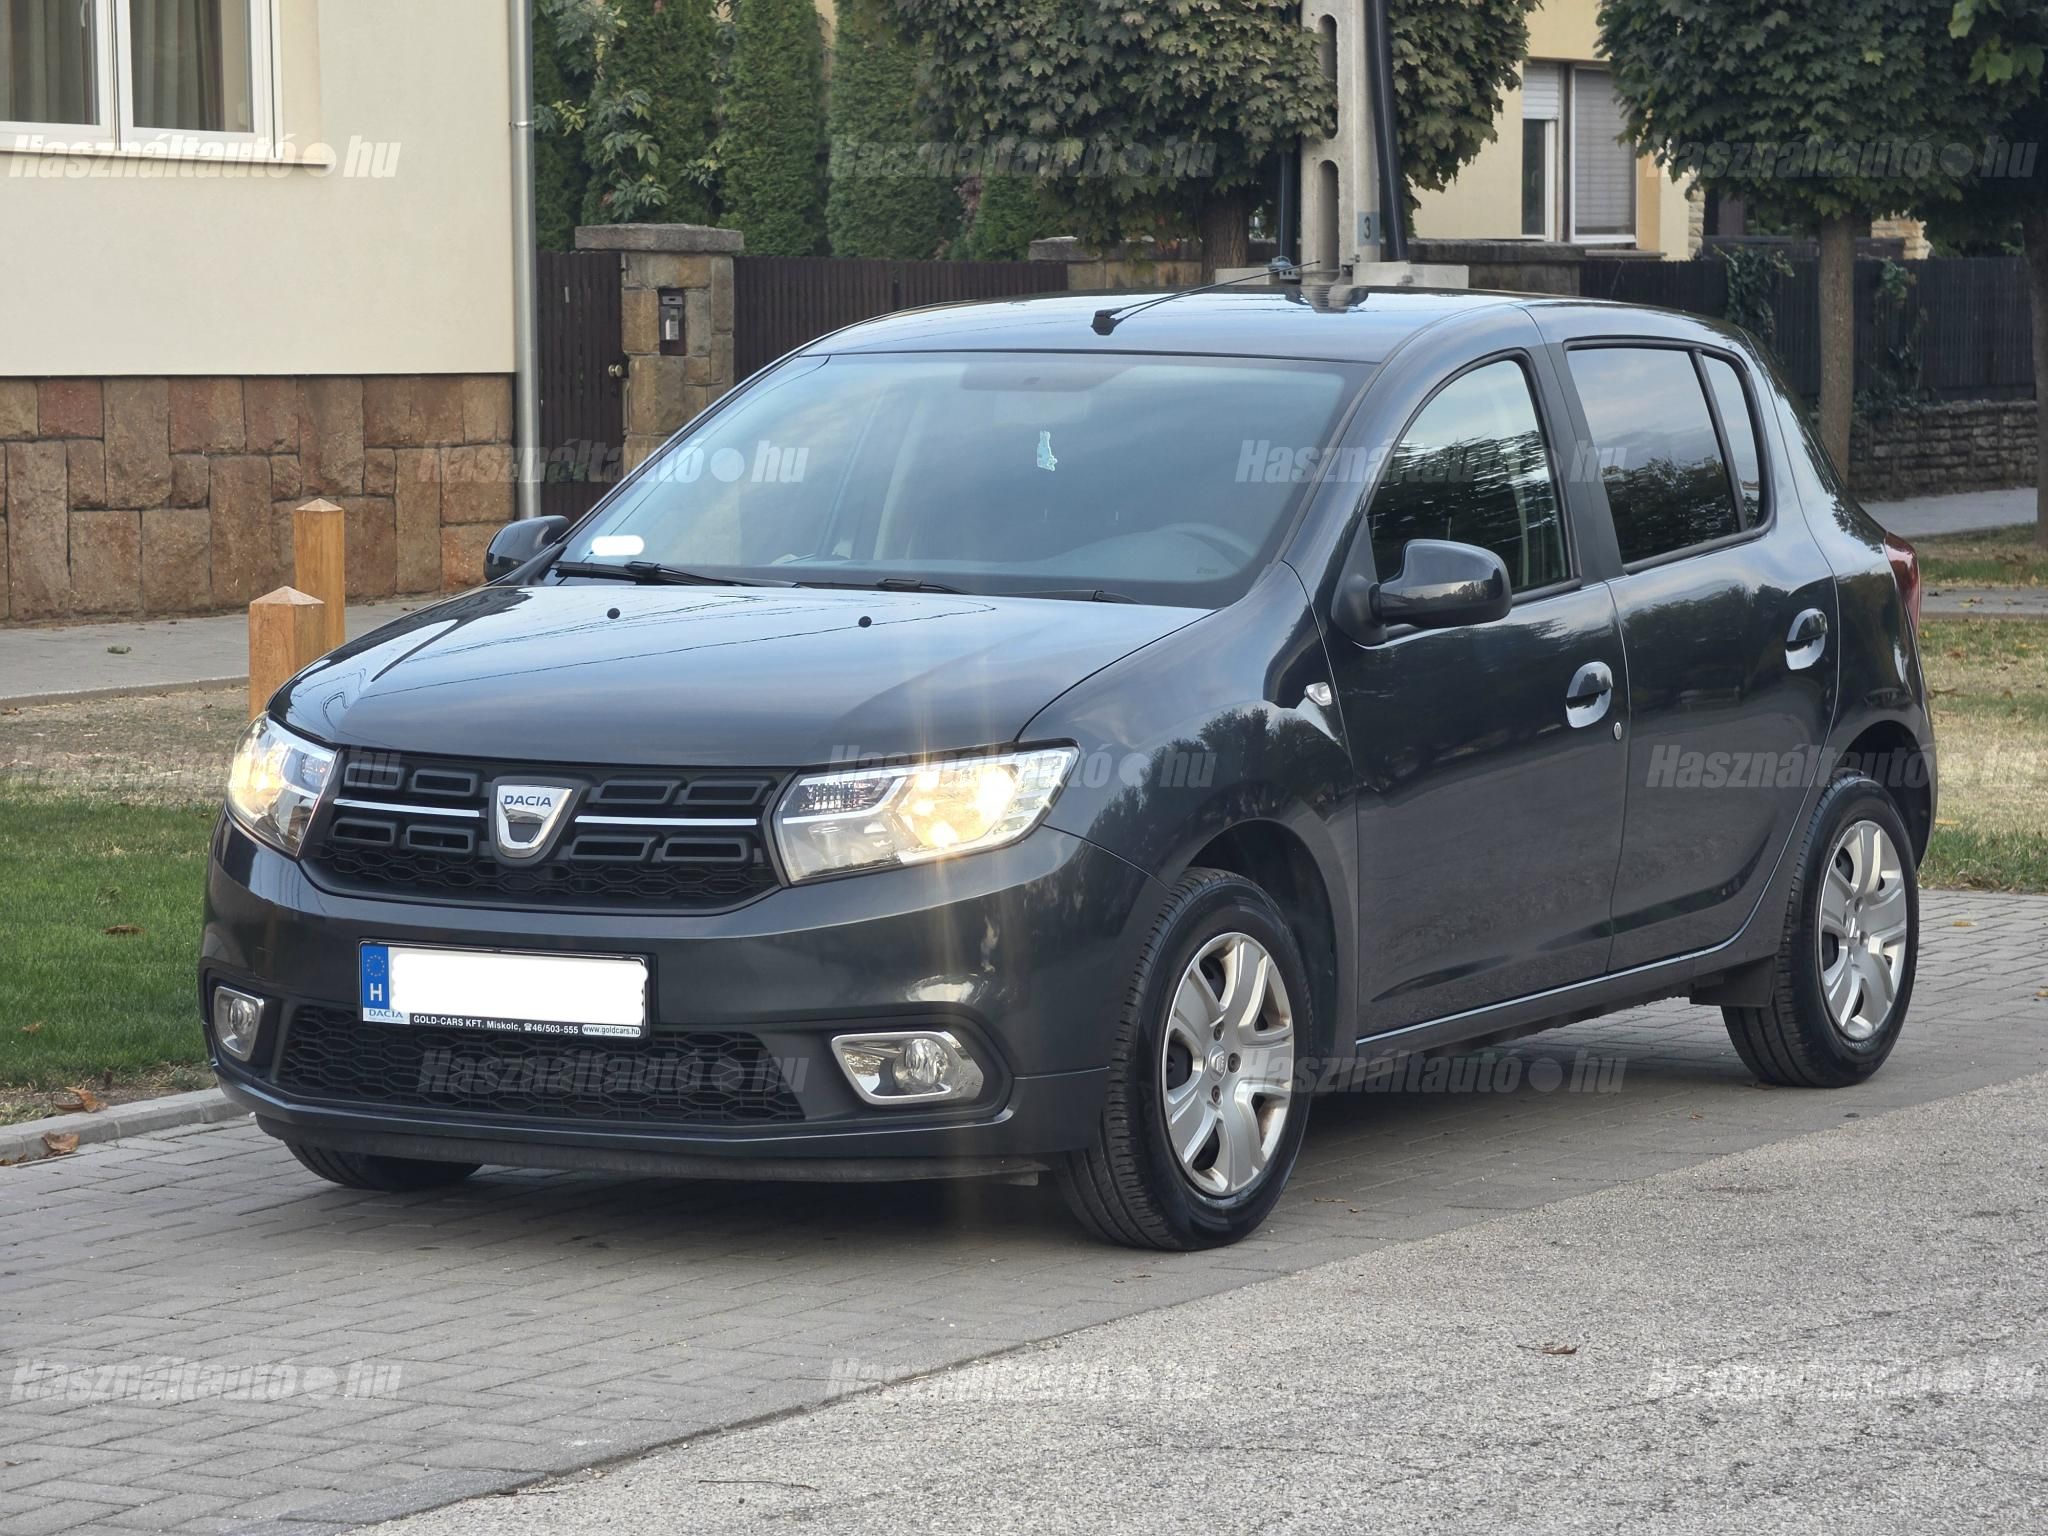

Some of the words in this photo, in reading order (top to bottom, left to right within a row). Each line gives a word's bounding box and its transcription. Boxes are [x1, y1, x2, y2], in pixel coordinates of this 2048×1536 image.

[1363, 216, 1371, 240] 3
[503, 795, 552, 808] DACIA
[370, 983, 383, 1002] H
[368, 1009, 404, 1019] DACIA
[413, 1015, 464, 1027] GOLD-CARS
[465, 1018, 485, 1029] KFT.
[486, 1020, 522, 1032] Miskolc,
[582, 1025, 640, 1036] www.goldcars.hu
